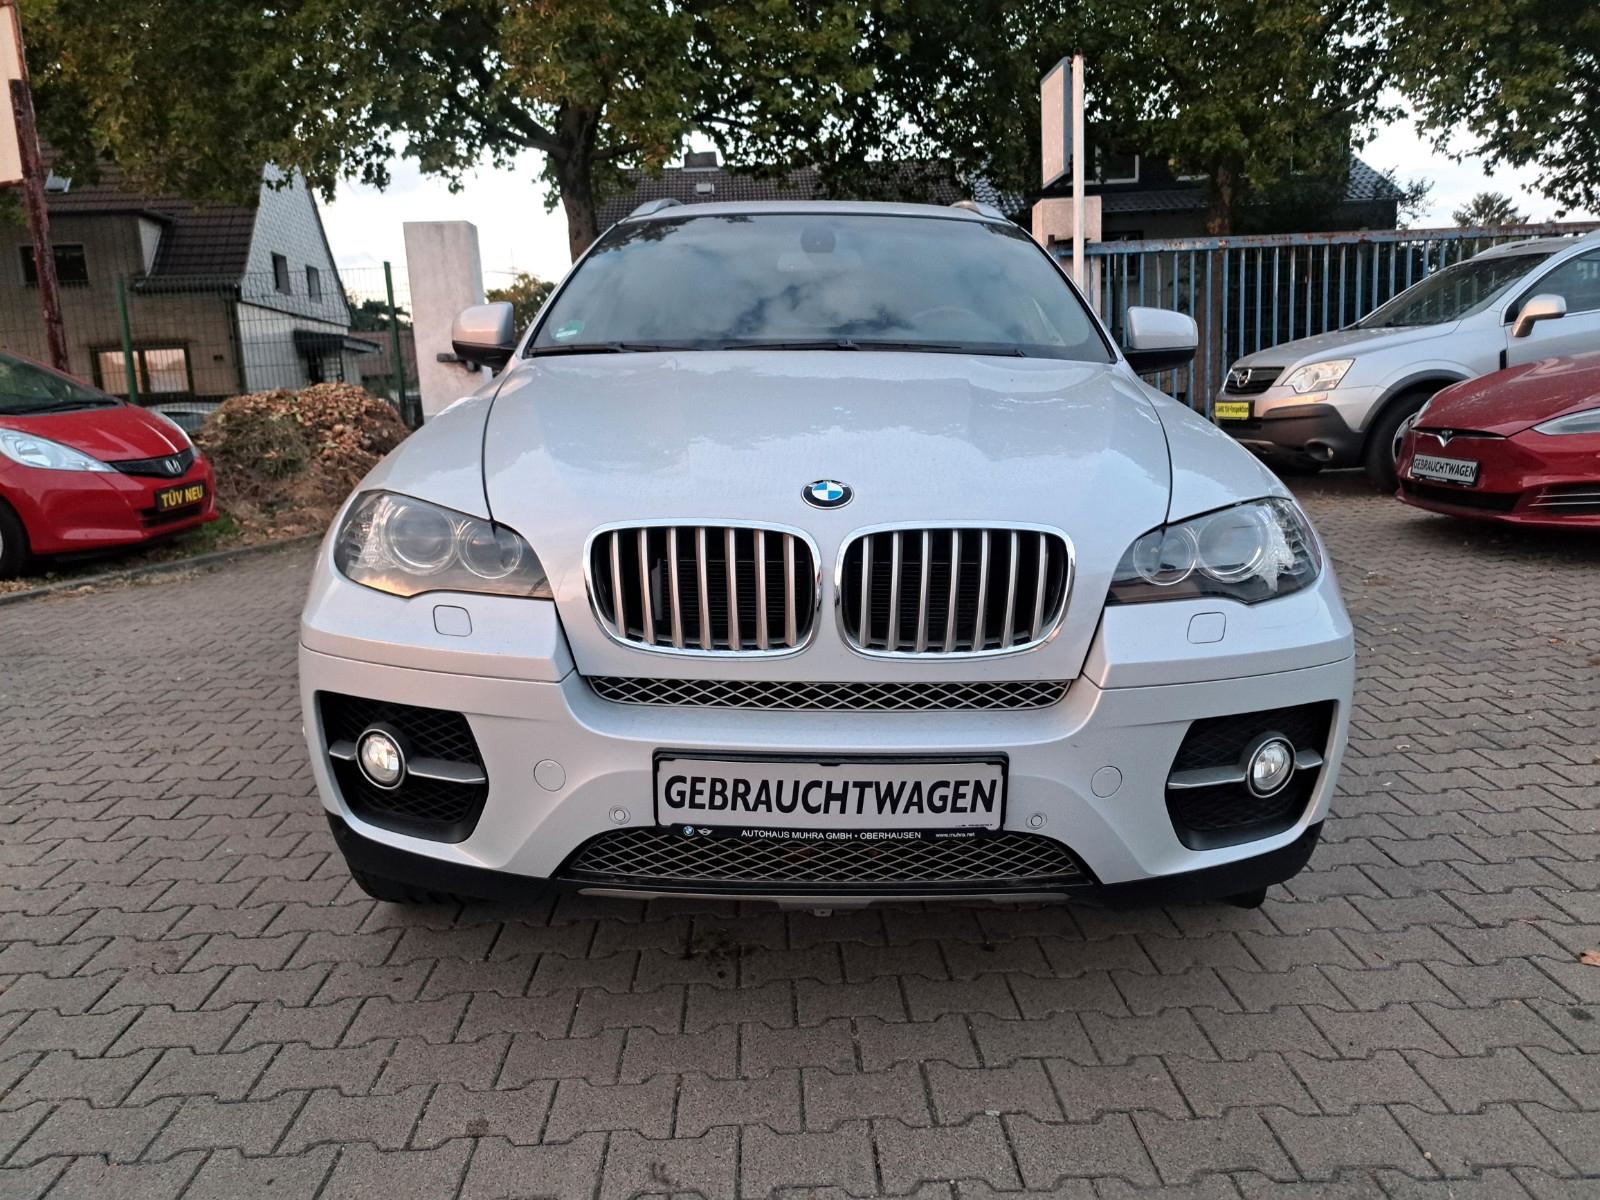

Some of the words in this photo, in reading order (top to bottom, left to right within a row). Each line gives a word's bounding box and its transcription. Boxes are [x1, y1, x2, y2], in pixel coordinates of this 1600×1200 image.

[1414, 458, 1476, 478] GEBRAUCHTWAGEN
[161, 489, 183, 507] TÜV
[185, 484, 203, 503] NEU
[664, 775, 997, 815] GEBRAUCHTWAGEN
[741, 830, 790, 839] AUTOHAUS
[791, 832, 824, 840] MUHRA
[826, 832, 852, 840] GMBH
[860, 832, 921, 840] OBERHAUSEN
